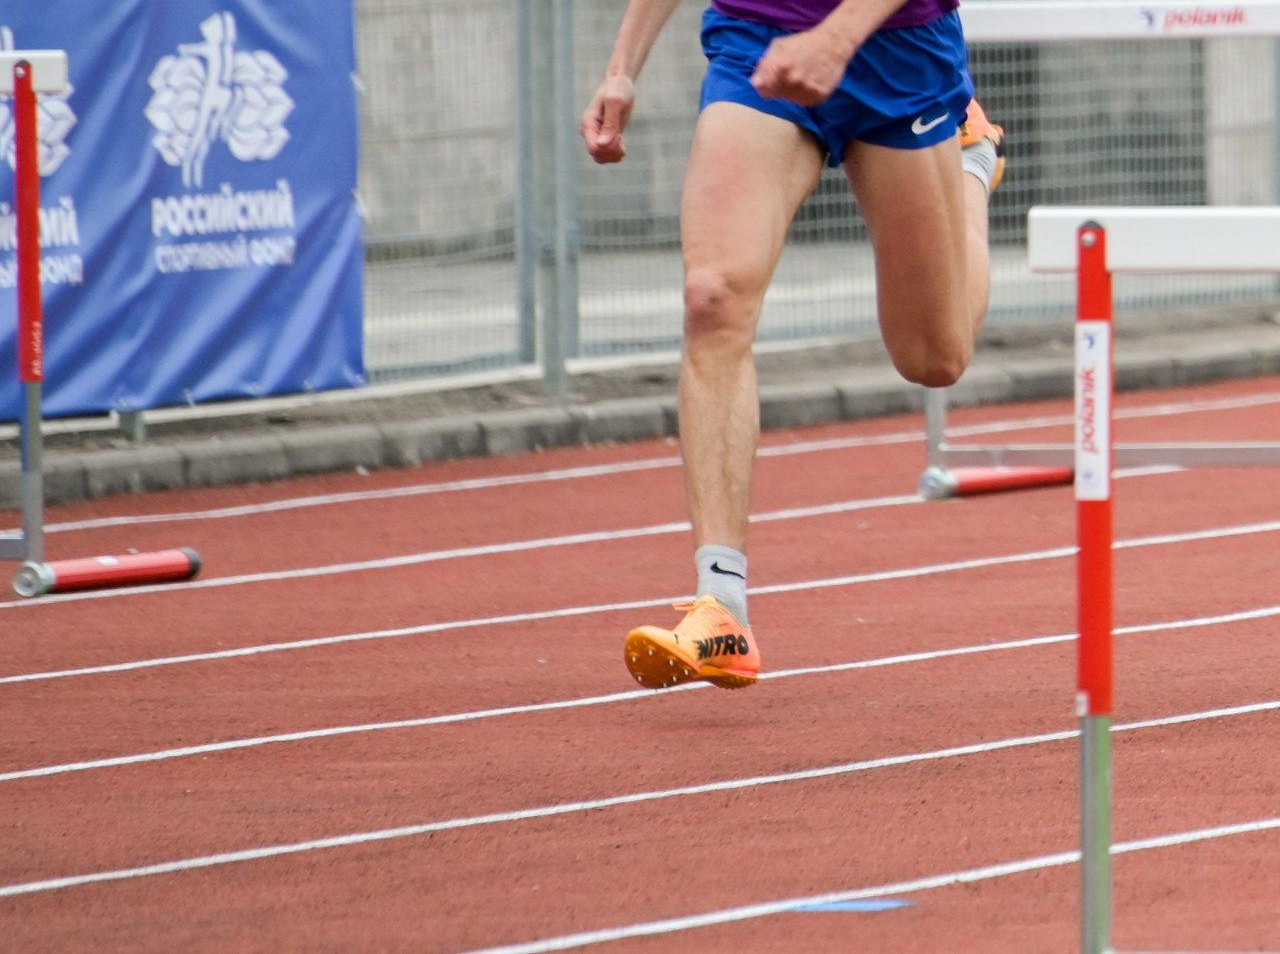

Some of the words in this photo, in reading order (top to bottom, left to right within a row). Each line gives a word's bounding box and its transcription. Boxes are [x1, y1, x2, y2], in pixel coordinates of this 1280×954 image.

[1163, 6, 1248, 34] polanik
[151, 178, 295, 238] РОССИЙСКИЙ
[1081, 364, 1099, 455] polanik
[693, 634, 749, 660] NITRO
